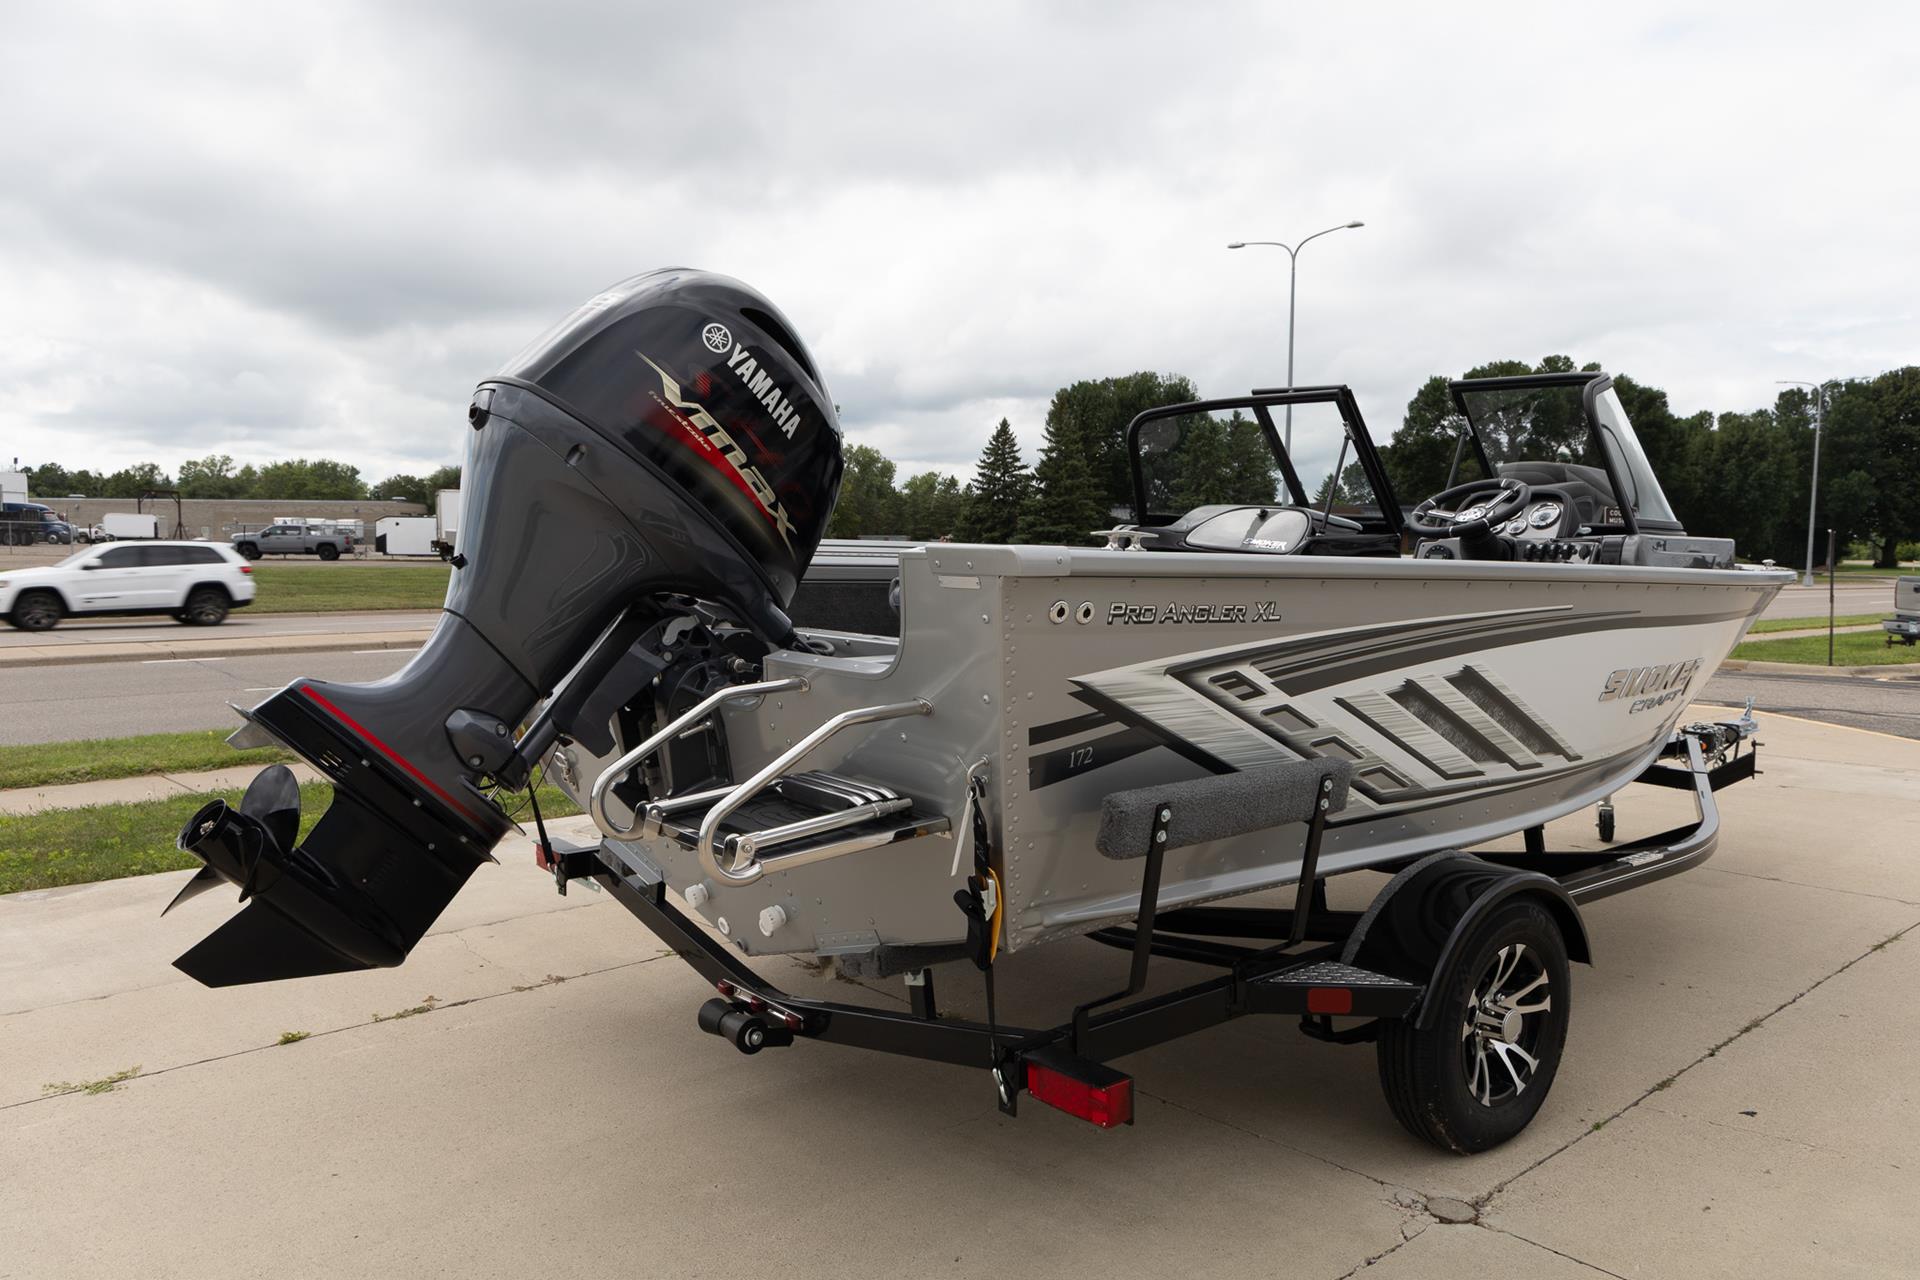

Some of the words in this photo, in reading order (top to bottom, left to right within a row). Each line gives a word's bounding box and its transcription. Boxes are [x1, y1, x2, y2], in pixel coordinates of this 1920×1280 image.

[727, 343, 801, 440] YAMAHA
[1252, 601, 1281, 623] XL
[1629, 688, 1682, 714] CRAFT
[1069, 746, 1093, 768] 172
